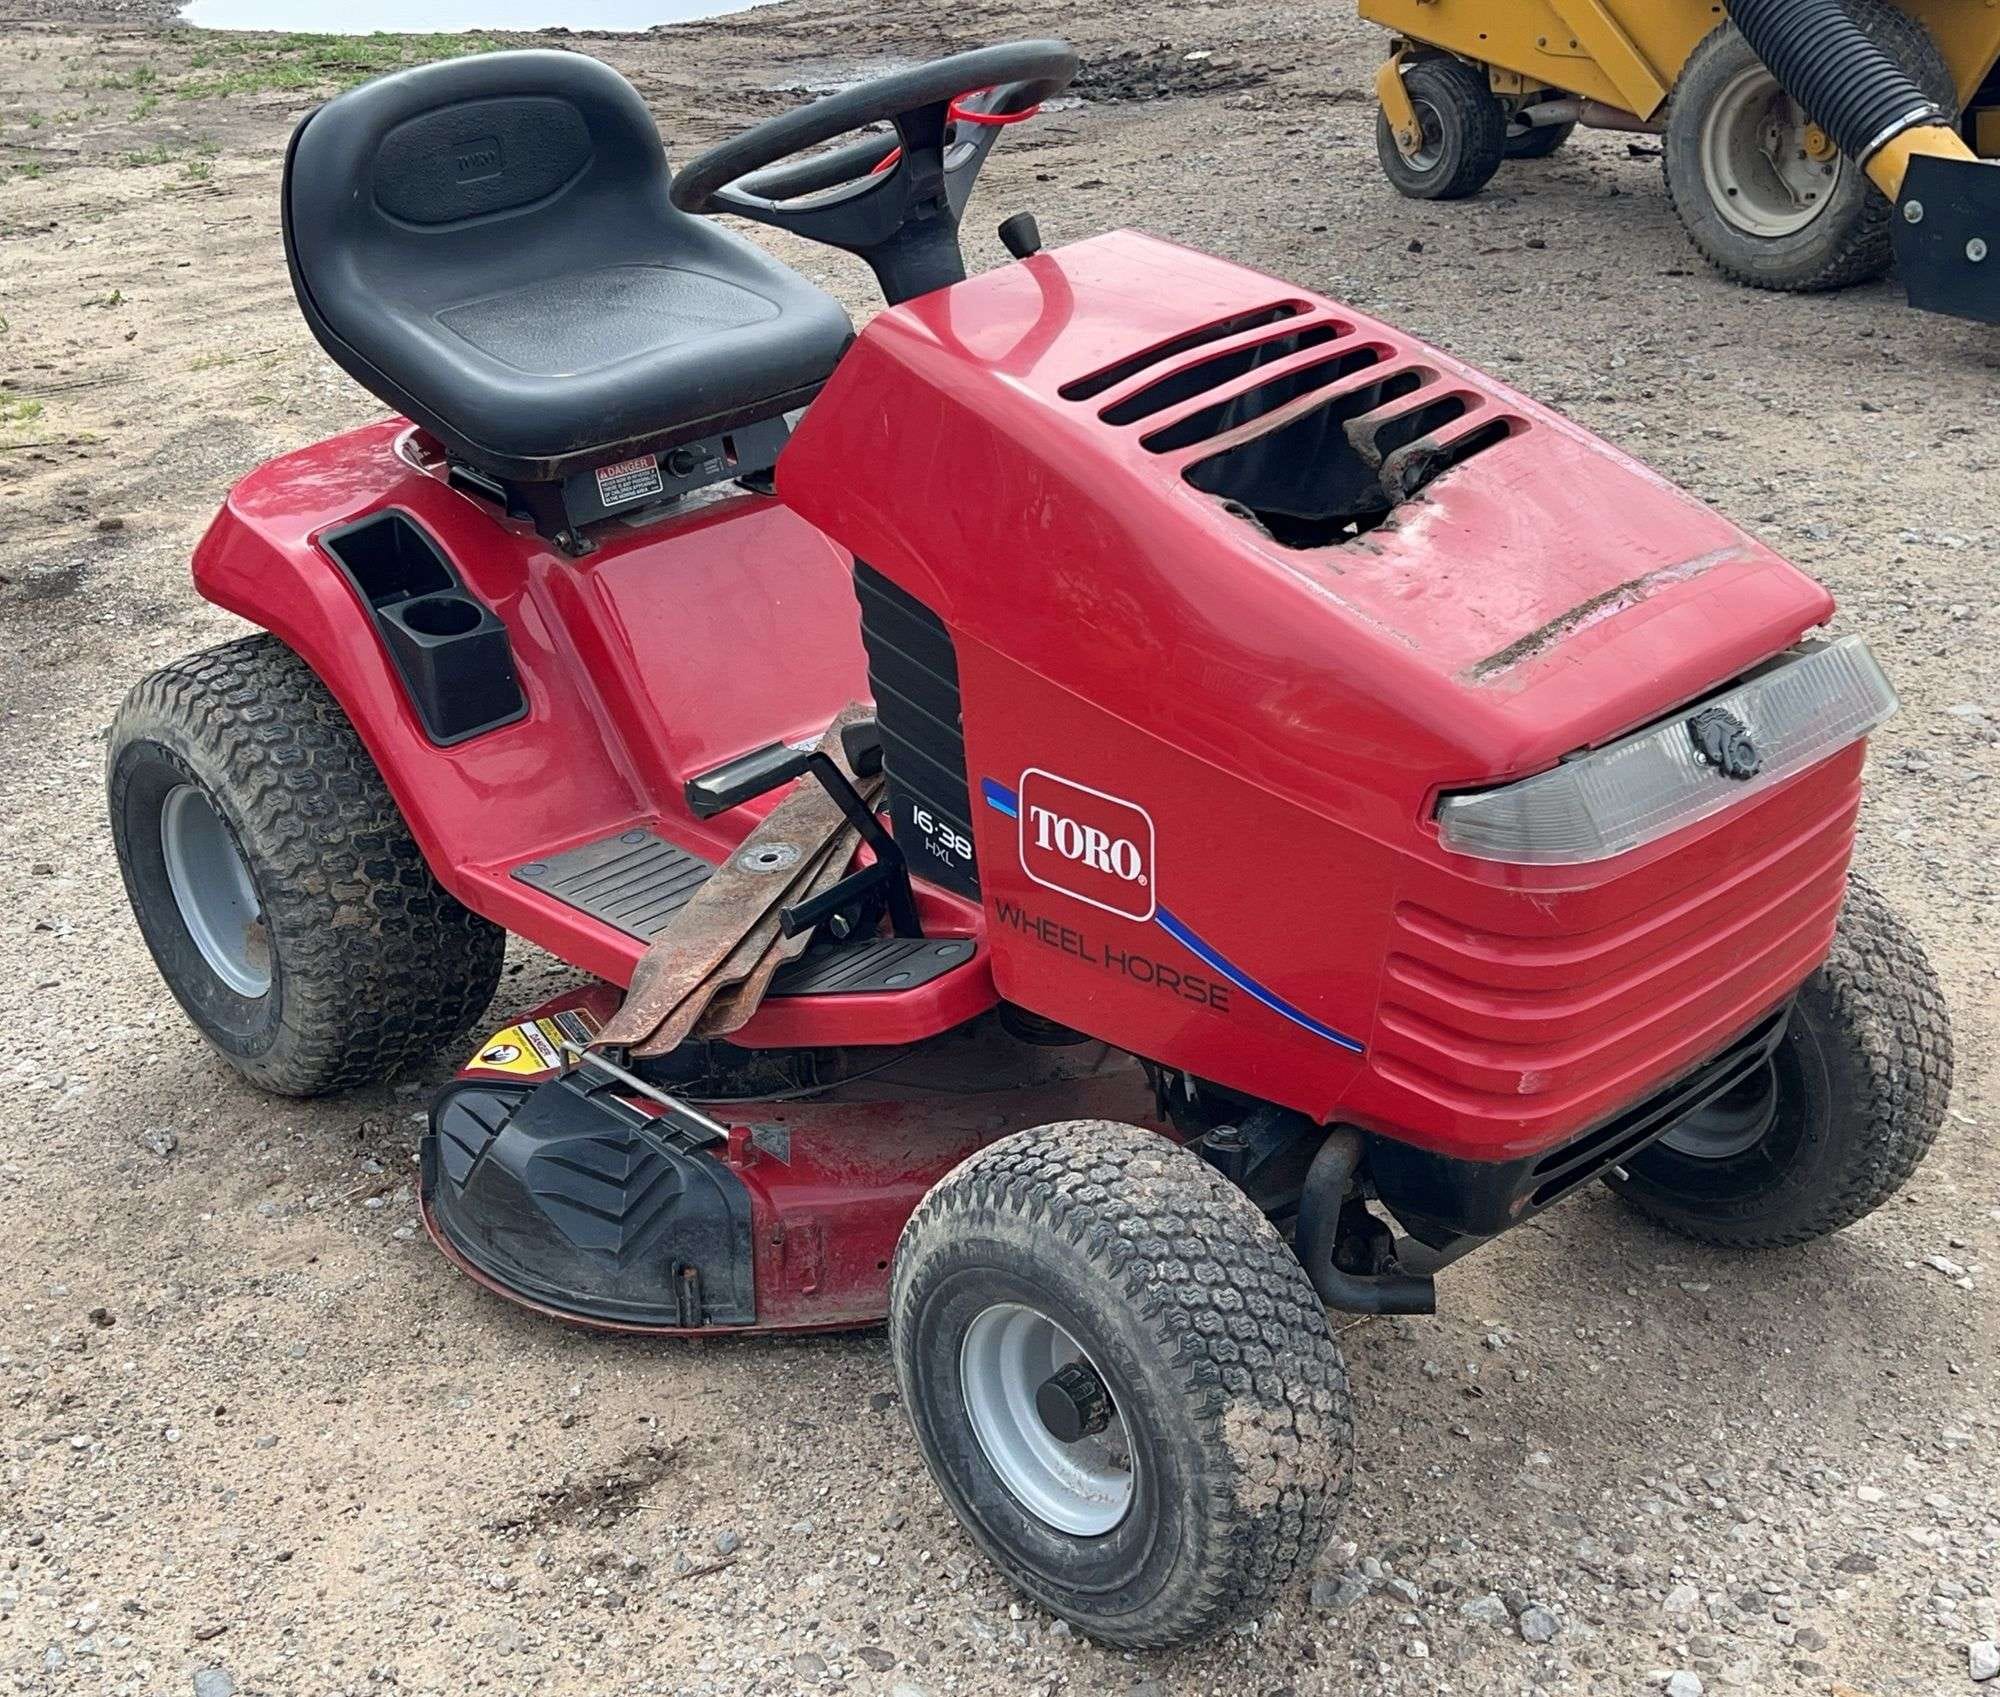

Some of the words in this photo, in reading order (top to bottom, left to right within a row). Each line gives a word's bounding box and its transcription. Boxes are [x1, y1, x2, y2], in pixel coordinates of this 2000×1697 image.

[608, 458, 648, 476] DANGER
[925, 837, 955, 868] HXL
[1030, 804, 1142, 882] TORO
[994, 897, 1097, 962] WHEEL
[1105, 943, 1230, 1013] HORSE
[529, 1033, 551, 1056] DANGER
